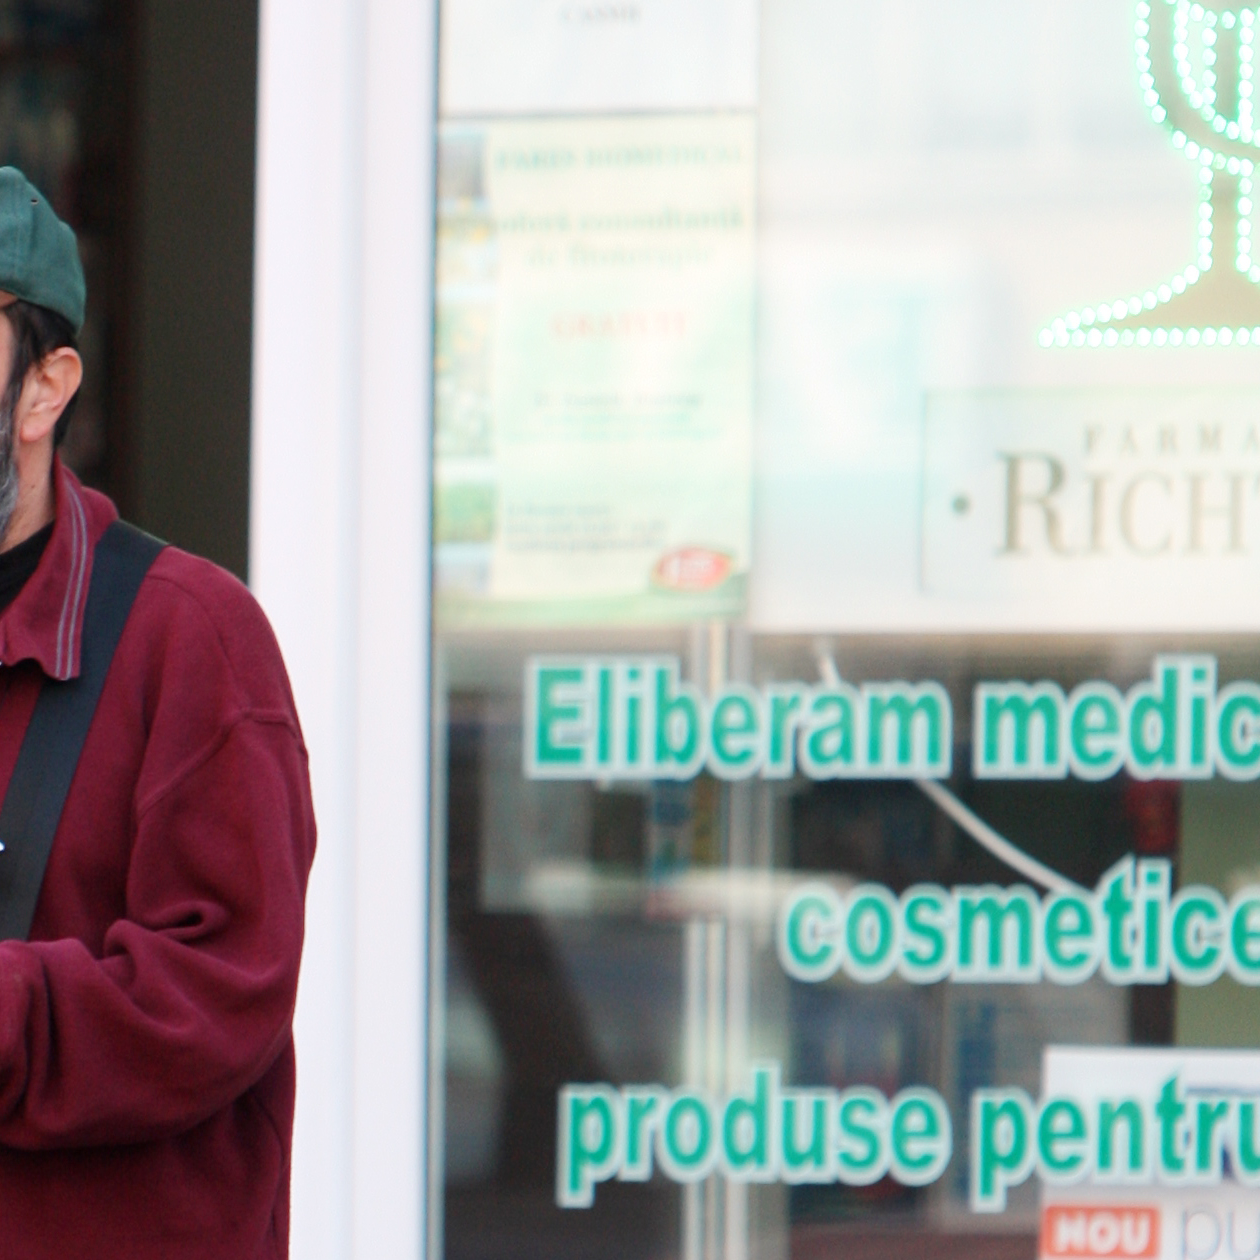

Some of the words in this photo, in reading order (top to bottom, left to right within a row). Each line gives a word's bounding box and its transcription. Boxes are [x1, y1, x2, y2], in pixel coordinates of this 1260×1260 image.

[1083, 423, 1260, 454] FARMA
[994, 450, 1260, 556] RICH
[526, 657, 951, 778] Eliberam
[974, 657, 1260, 780] medic
[781, 857, 1260, 983] cosmetice
[559, 1061, 951, 1207] produse
